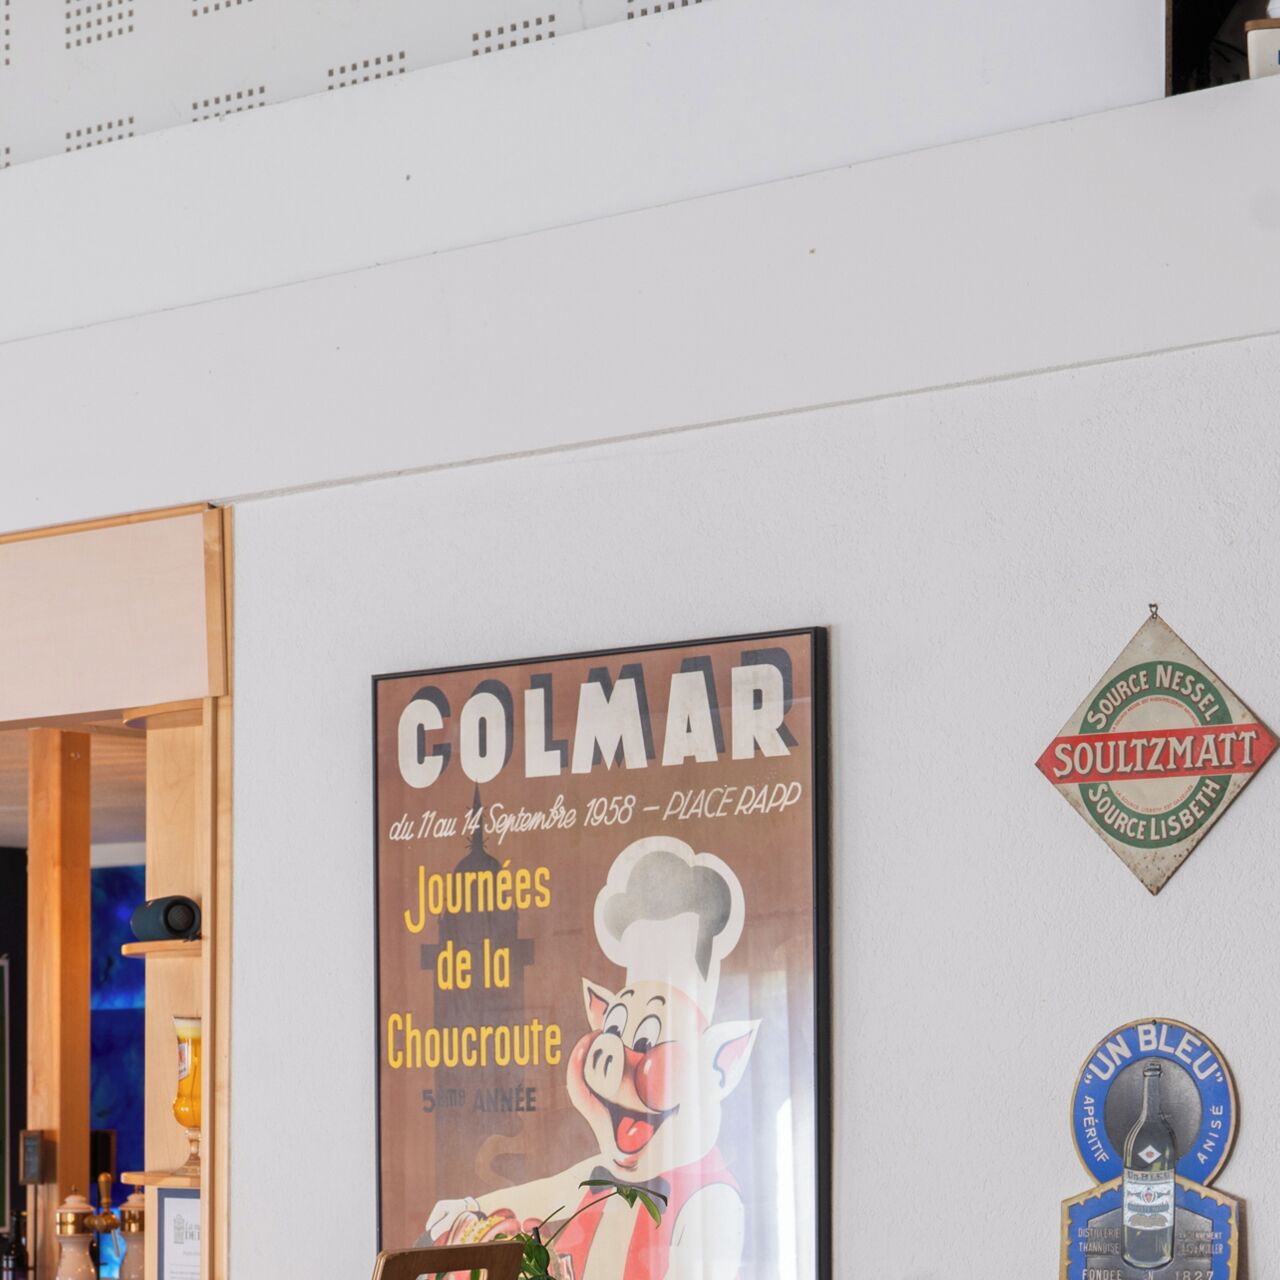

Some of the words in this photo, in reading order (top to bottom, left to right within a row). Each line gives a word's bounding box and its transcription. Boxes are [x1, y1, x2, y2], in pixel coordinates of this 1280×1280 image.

[397, 655, 794, 789] COLMAR
[1087, 670, 1149, 730] SOURCE
[1156, 664, 1220, 722] NESSEL
[1053, 730, 1258, 778] SOULTZMATT
[389, 812, 414, 841] du
[433, 817, 456, 837] au
[461, 807, 480, 836] 14
[484, 794, 577, 845] Septembre
[583, 795, 635, 827] 1958
[663, 787, 736, 821] PLACE
[735, 781, 803, 815] RAPP
[1089, 783, 1146, 840] SOURCE
[1150, 778, 1221, 841] LISBETH
[404, 860, 551, 934] Journées
[437, 941, 472, 990] de
[483, 938, 510, 989] la
[388, 1011, 561, 1069] Choucroute
[473, 1084, 537, 1112] ANNÉE
[1083, 1095, 1110, 1164] APÉRITIF
[1197, 1104, 1224, 1165] ANISÉ
